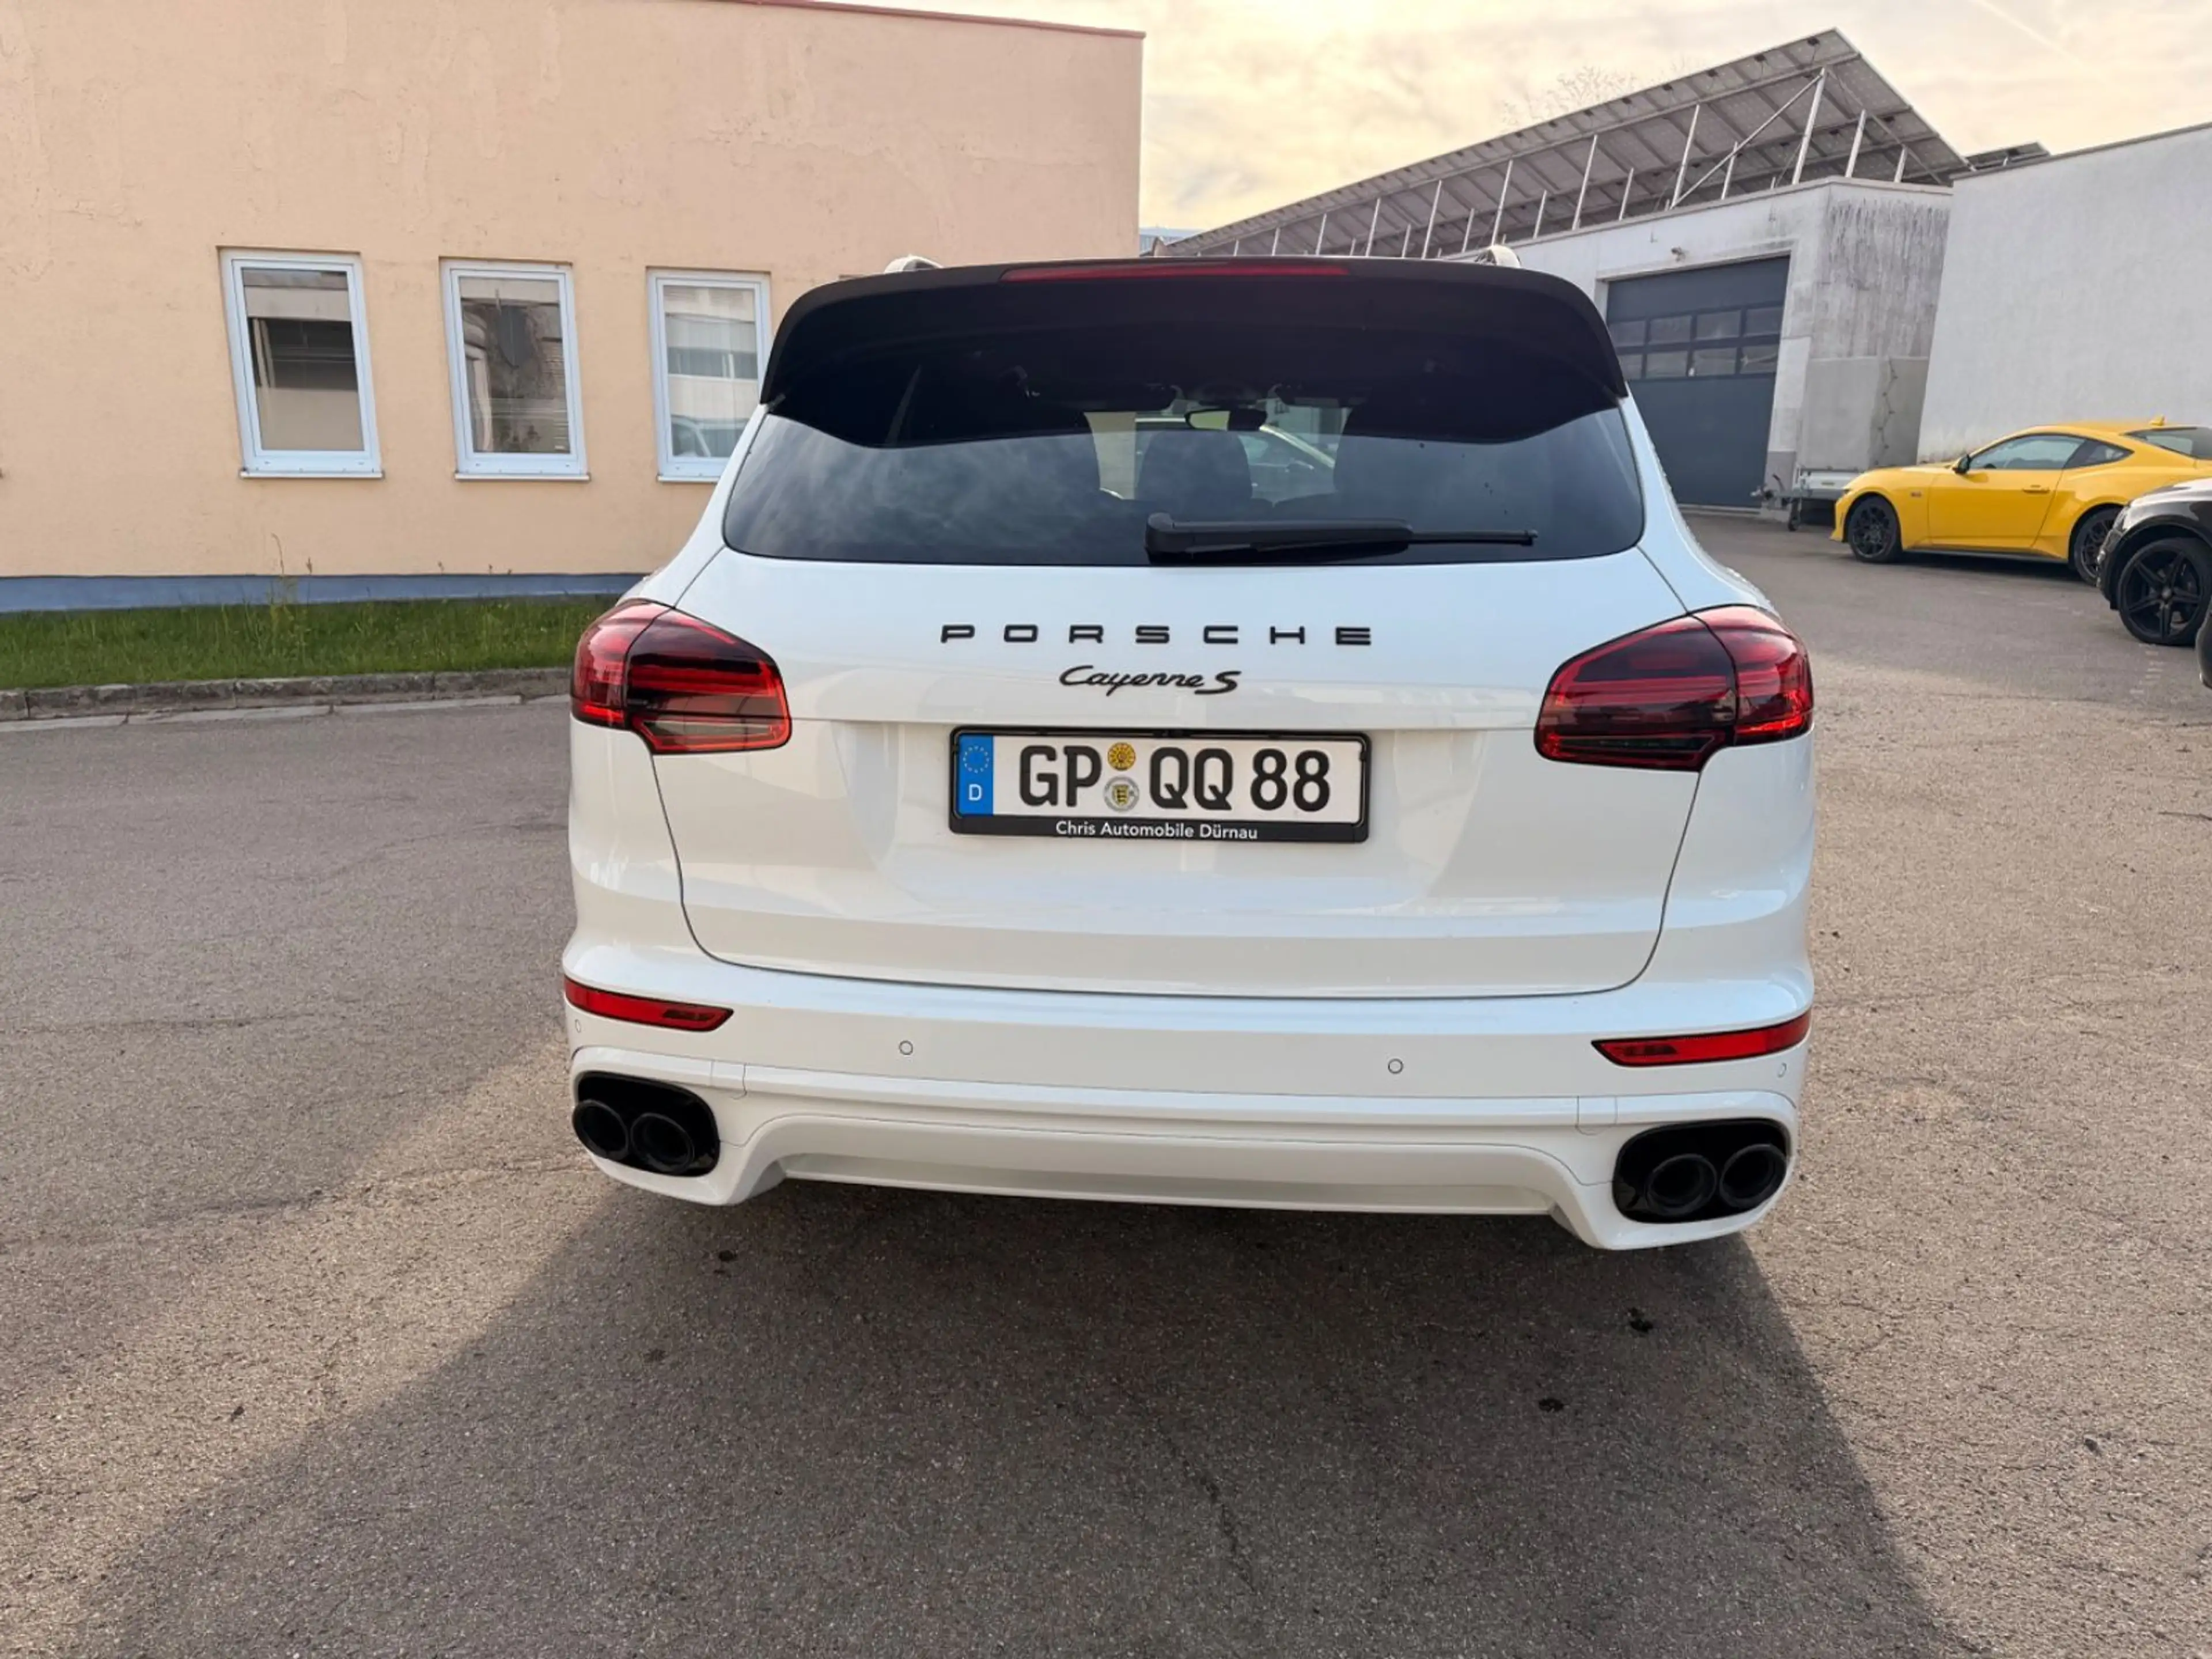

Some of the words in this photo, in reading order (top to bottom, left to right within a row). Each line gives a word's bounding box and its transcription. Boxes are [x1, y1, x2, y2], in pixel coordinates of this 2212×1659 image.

[940, 624, 1372, 646] PORSCHE
[1059, 665, 1205, 697] Cayenne
[1194, 670, 1242, 695] S
[1019, 744, 1103, 808] GP
[1149, 746, 1234, 811] QQ
[1249, 748, 1331, 813] 88
[968, 783, 983, 801] D
[1055, 820, 1096, 836] Chris
[1100, 821, 1194, 838] Automobile
[1200, 823, 1258, 840] Dürnau
